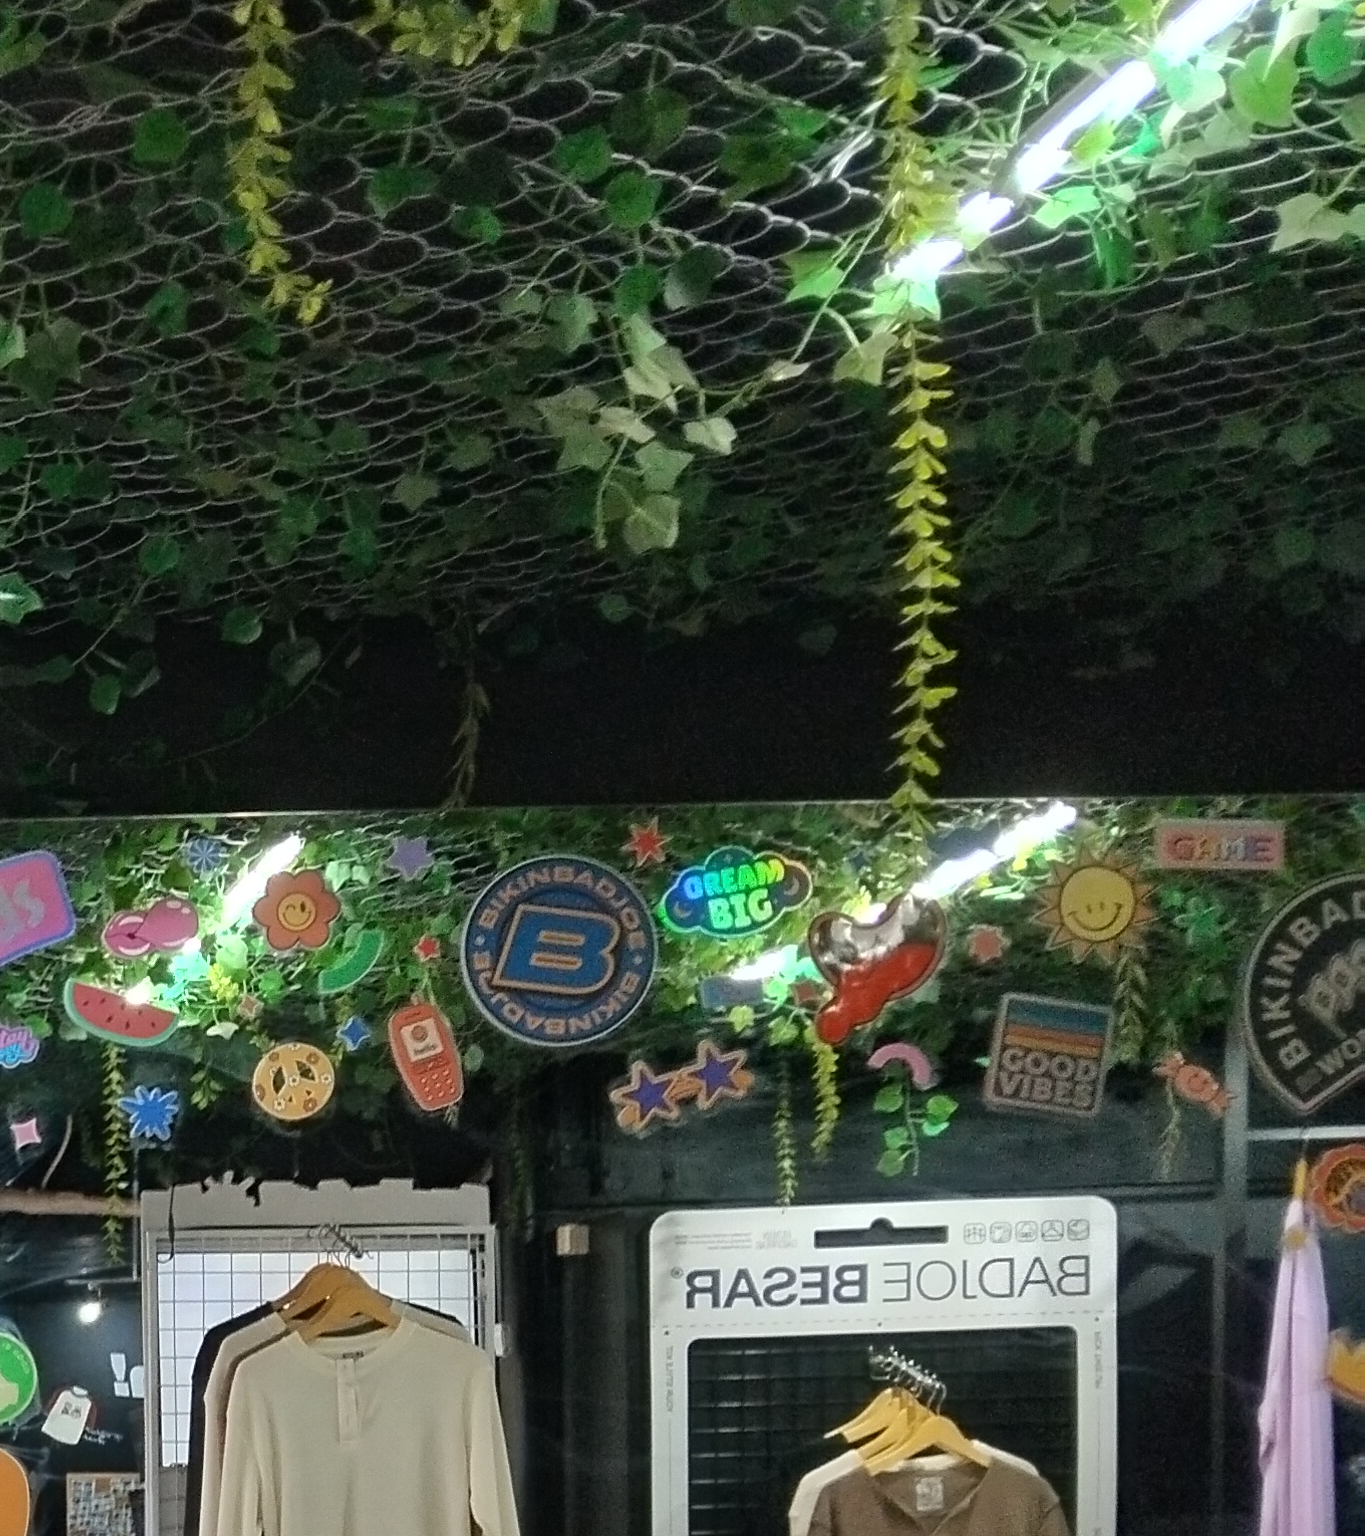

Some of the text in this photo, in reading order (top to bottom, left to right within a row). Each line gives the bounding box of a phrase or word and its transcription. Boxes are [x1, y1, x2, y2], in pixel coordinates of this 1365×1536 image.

[1171, 836, 1275, 862] GAME
[684, 859, 785, 900] DREAM
[478, 866, 646, 949] BIKINBADJOE
[708, 888, 773, 930] BIG
[1001, 1046, 1099, 1081] GOOD
[997, 1071, 1095, 1109] VIBES
